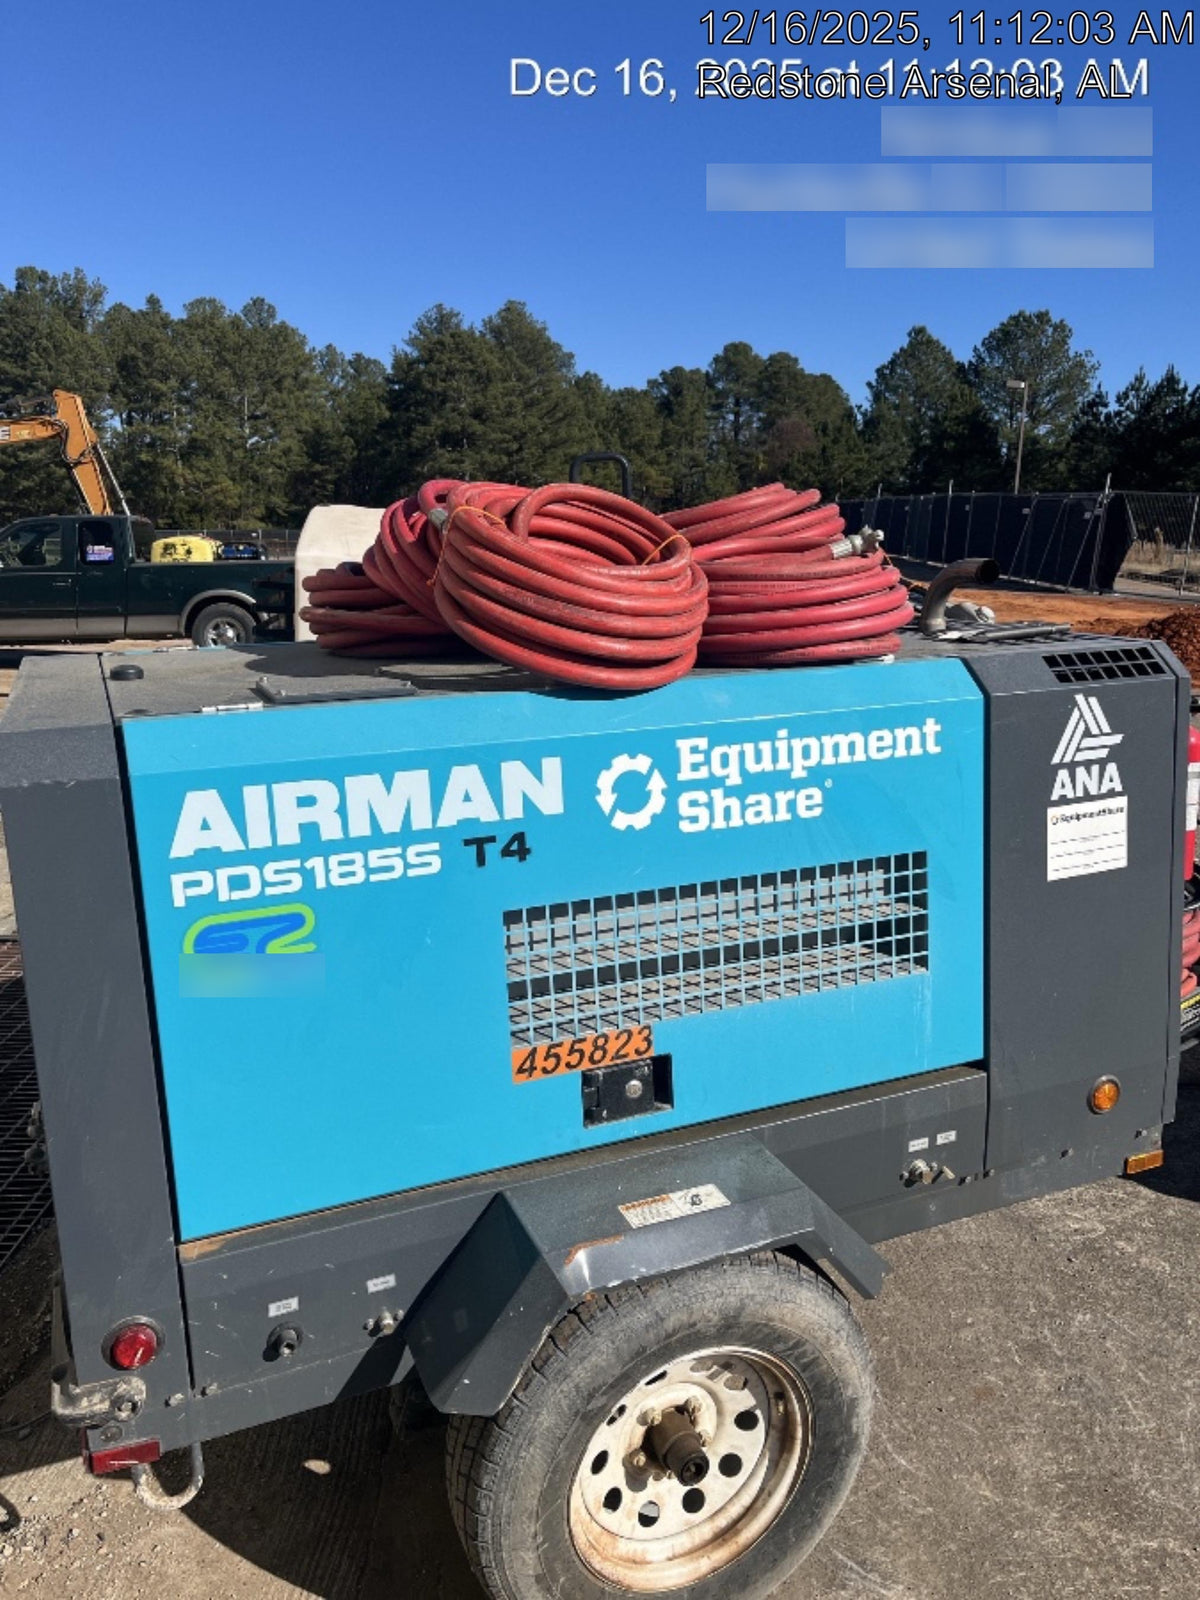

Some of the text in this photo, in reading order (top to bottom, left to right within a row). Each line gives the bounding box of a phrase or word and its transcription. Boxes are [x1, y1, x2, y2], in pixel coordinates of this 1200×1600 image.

[675, 717, 941, 786] Equipment
[1050, 762, 1123, 801] ANA
[168, 756, 565, 859] AIRMAN
[678, 785, 824, 833] Share
[169, 831, 532, 908] PDS185S T4
[515, 1025, 654, 1080] 455823
